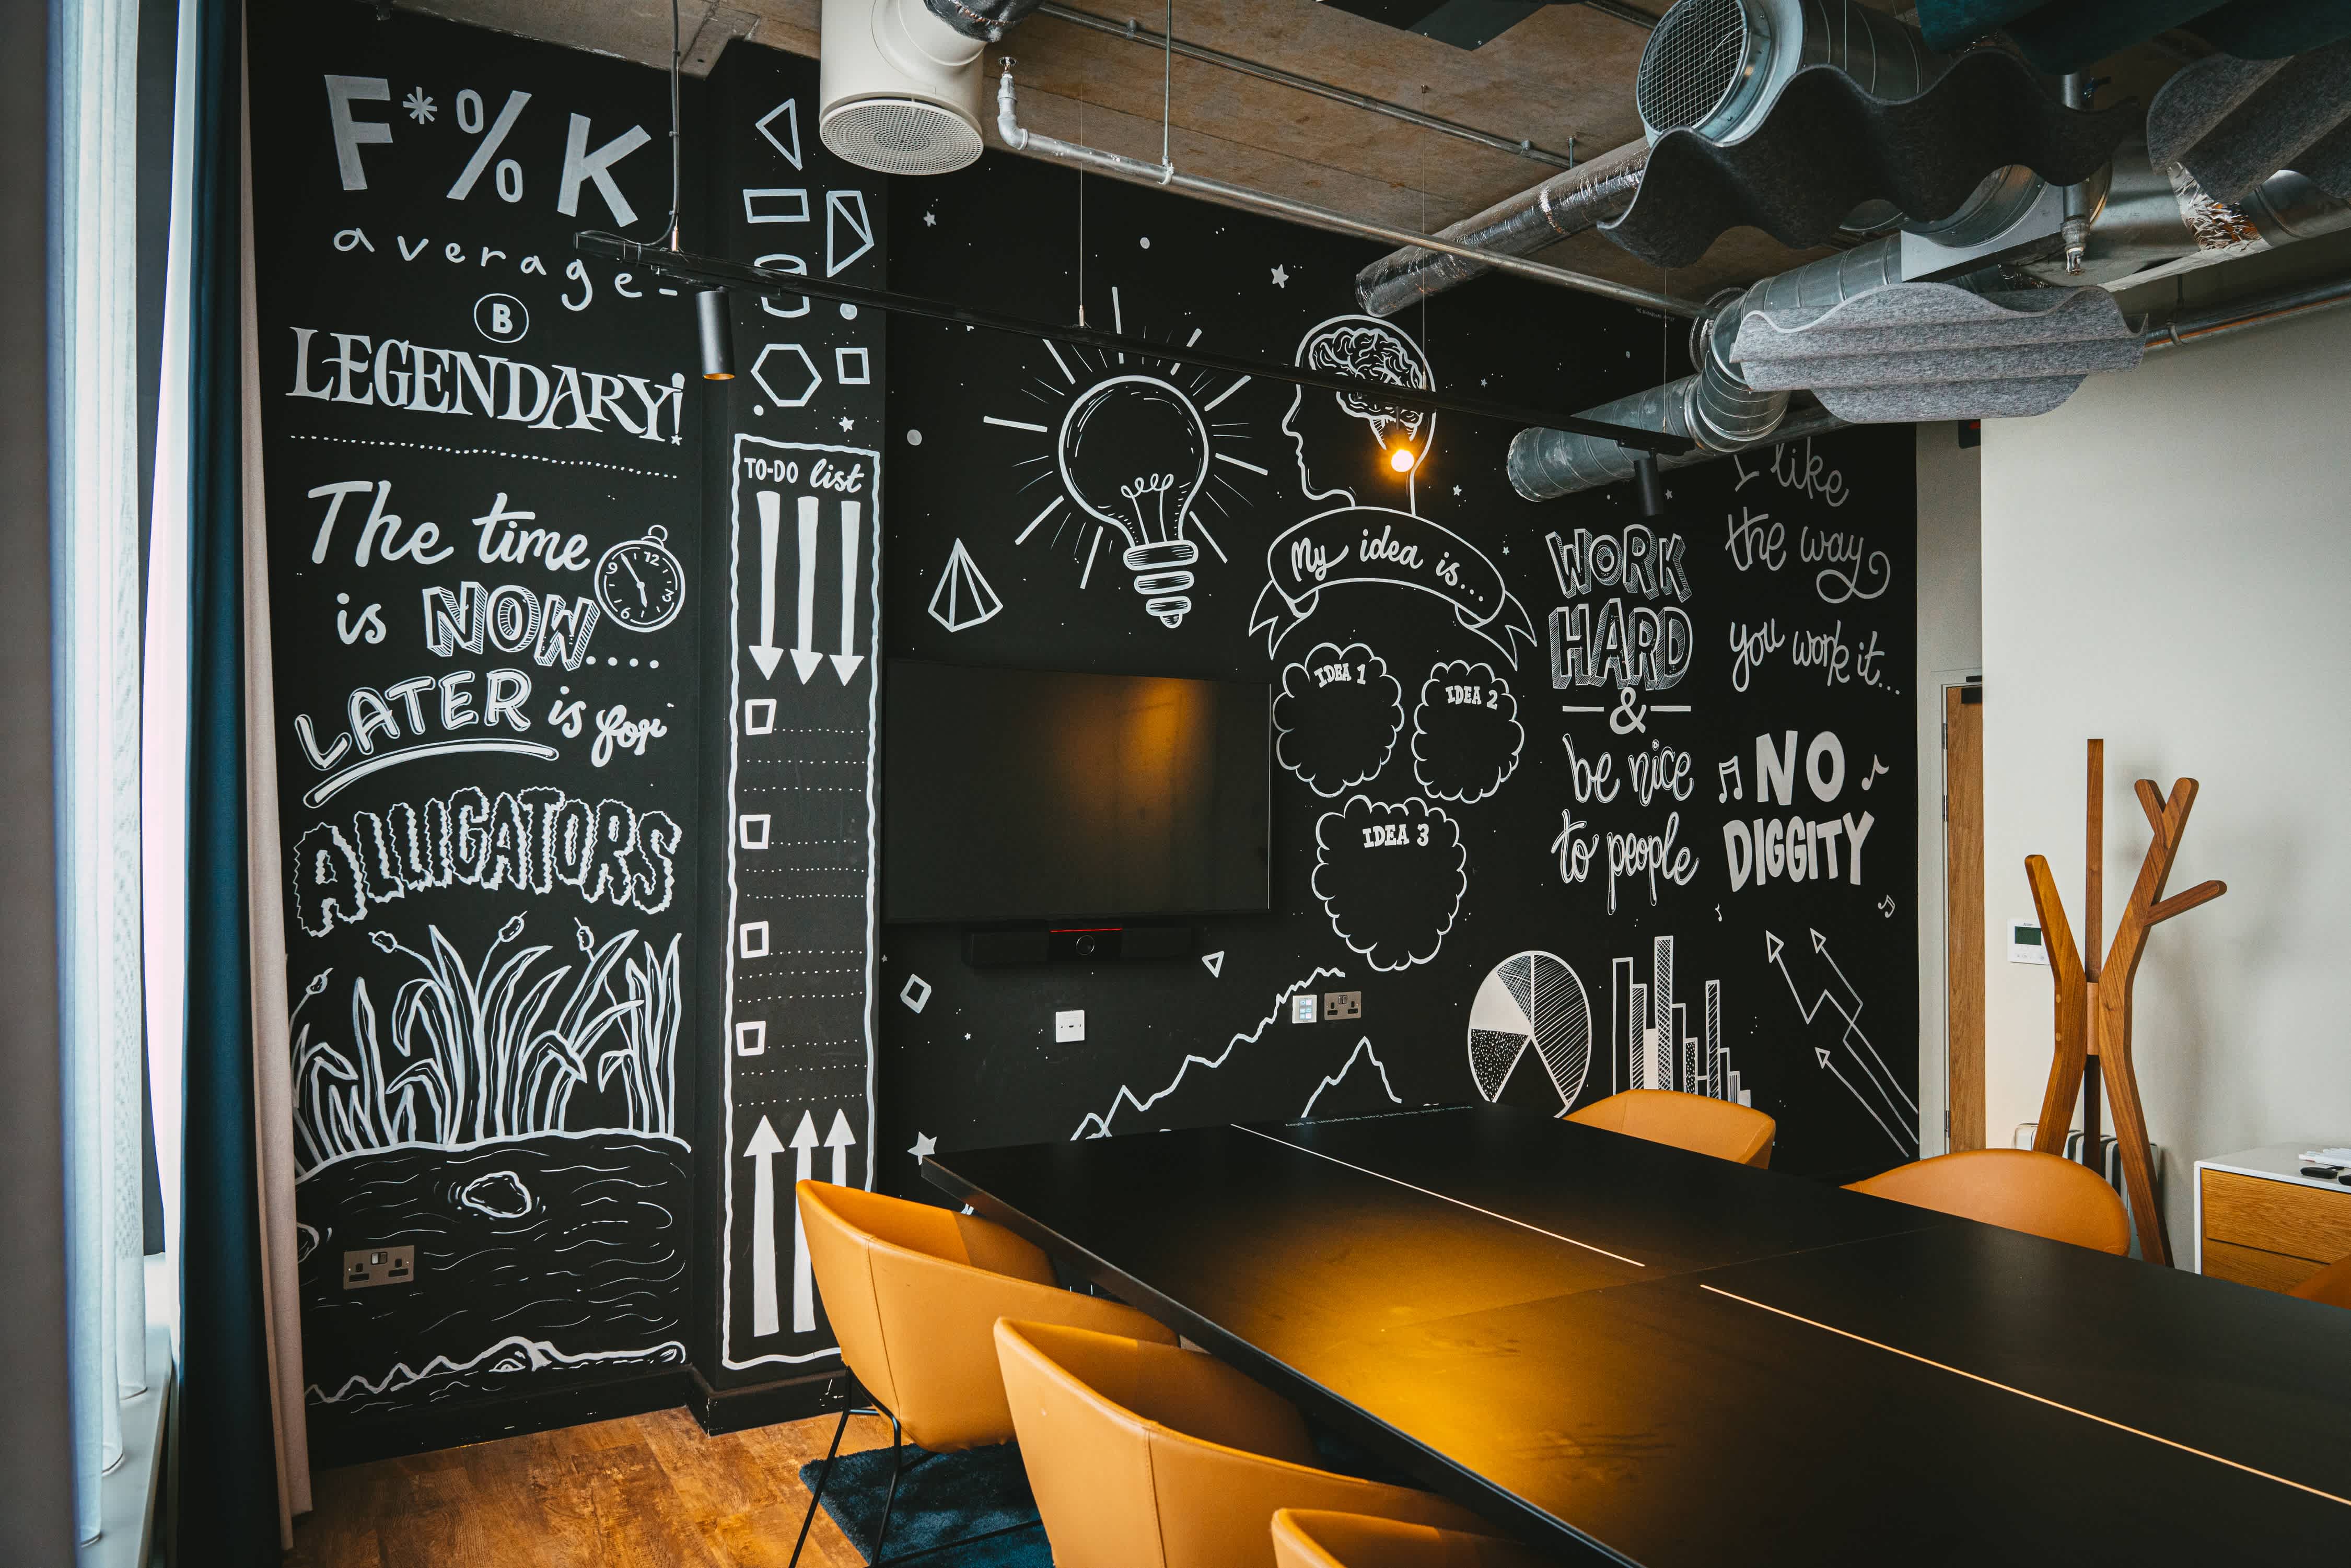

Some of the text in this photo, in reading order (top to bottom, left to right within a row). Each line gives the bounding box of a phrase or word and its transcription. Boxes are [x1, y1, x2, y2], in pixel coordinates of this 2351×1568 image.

[743, 457, 865, 493] TO-DO list
[1733, 436, 1850, 507] I like
[308, 479, 591, 571] The time
[643, 551, 659, 566] 12
[1291, 537, 1349, 582] My
[1359, 524, 1423, 569] idea
[1725, 506, 1891, 604] the way
[606, 561, 619, 575] 9
[661, 588, 674, 602] 3
[1545, 524, 1692, 603] WORK
[336, 592, 387, 645] is
[620, 607, 631, 619] 6
[1549, 598, 1693, 691] HARD
[1313, 663, 1367, 687] IDEA 1
[1730, 618, 1785, 692] you
[1793, 619, 1850, 687] work
[294, 668, 668, 770] LATER is for
[1445, 685, 1498, 710] IDEA 2
[1609, 686, 1647, 735] &
[1562, 733, 1694, 806] be nice
[1755, 730, 1845, 805] NO
[292, 786, 682, 938] ALLIGATORS
[1362, 823, 1429, 849] IDEA 3
[1551, 809, 1700, 916] to people
[1723, 810, 1875, 893] DIGGITY
